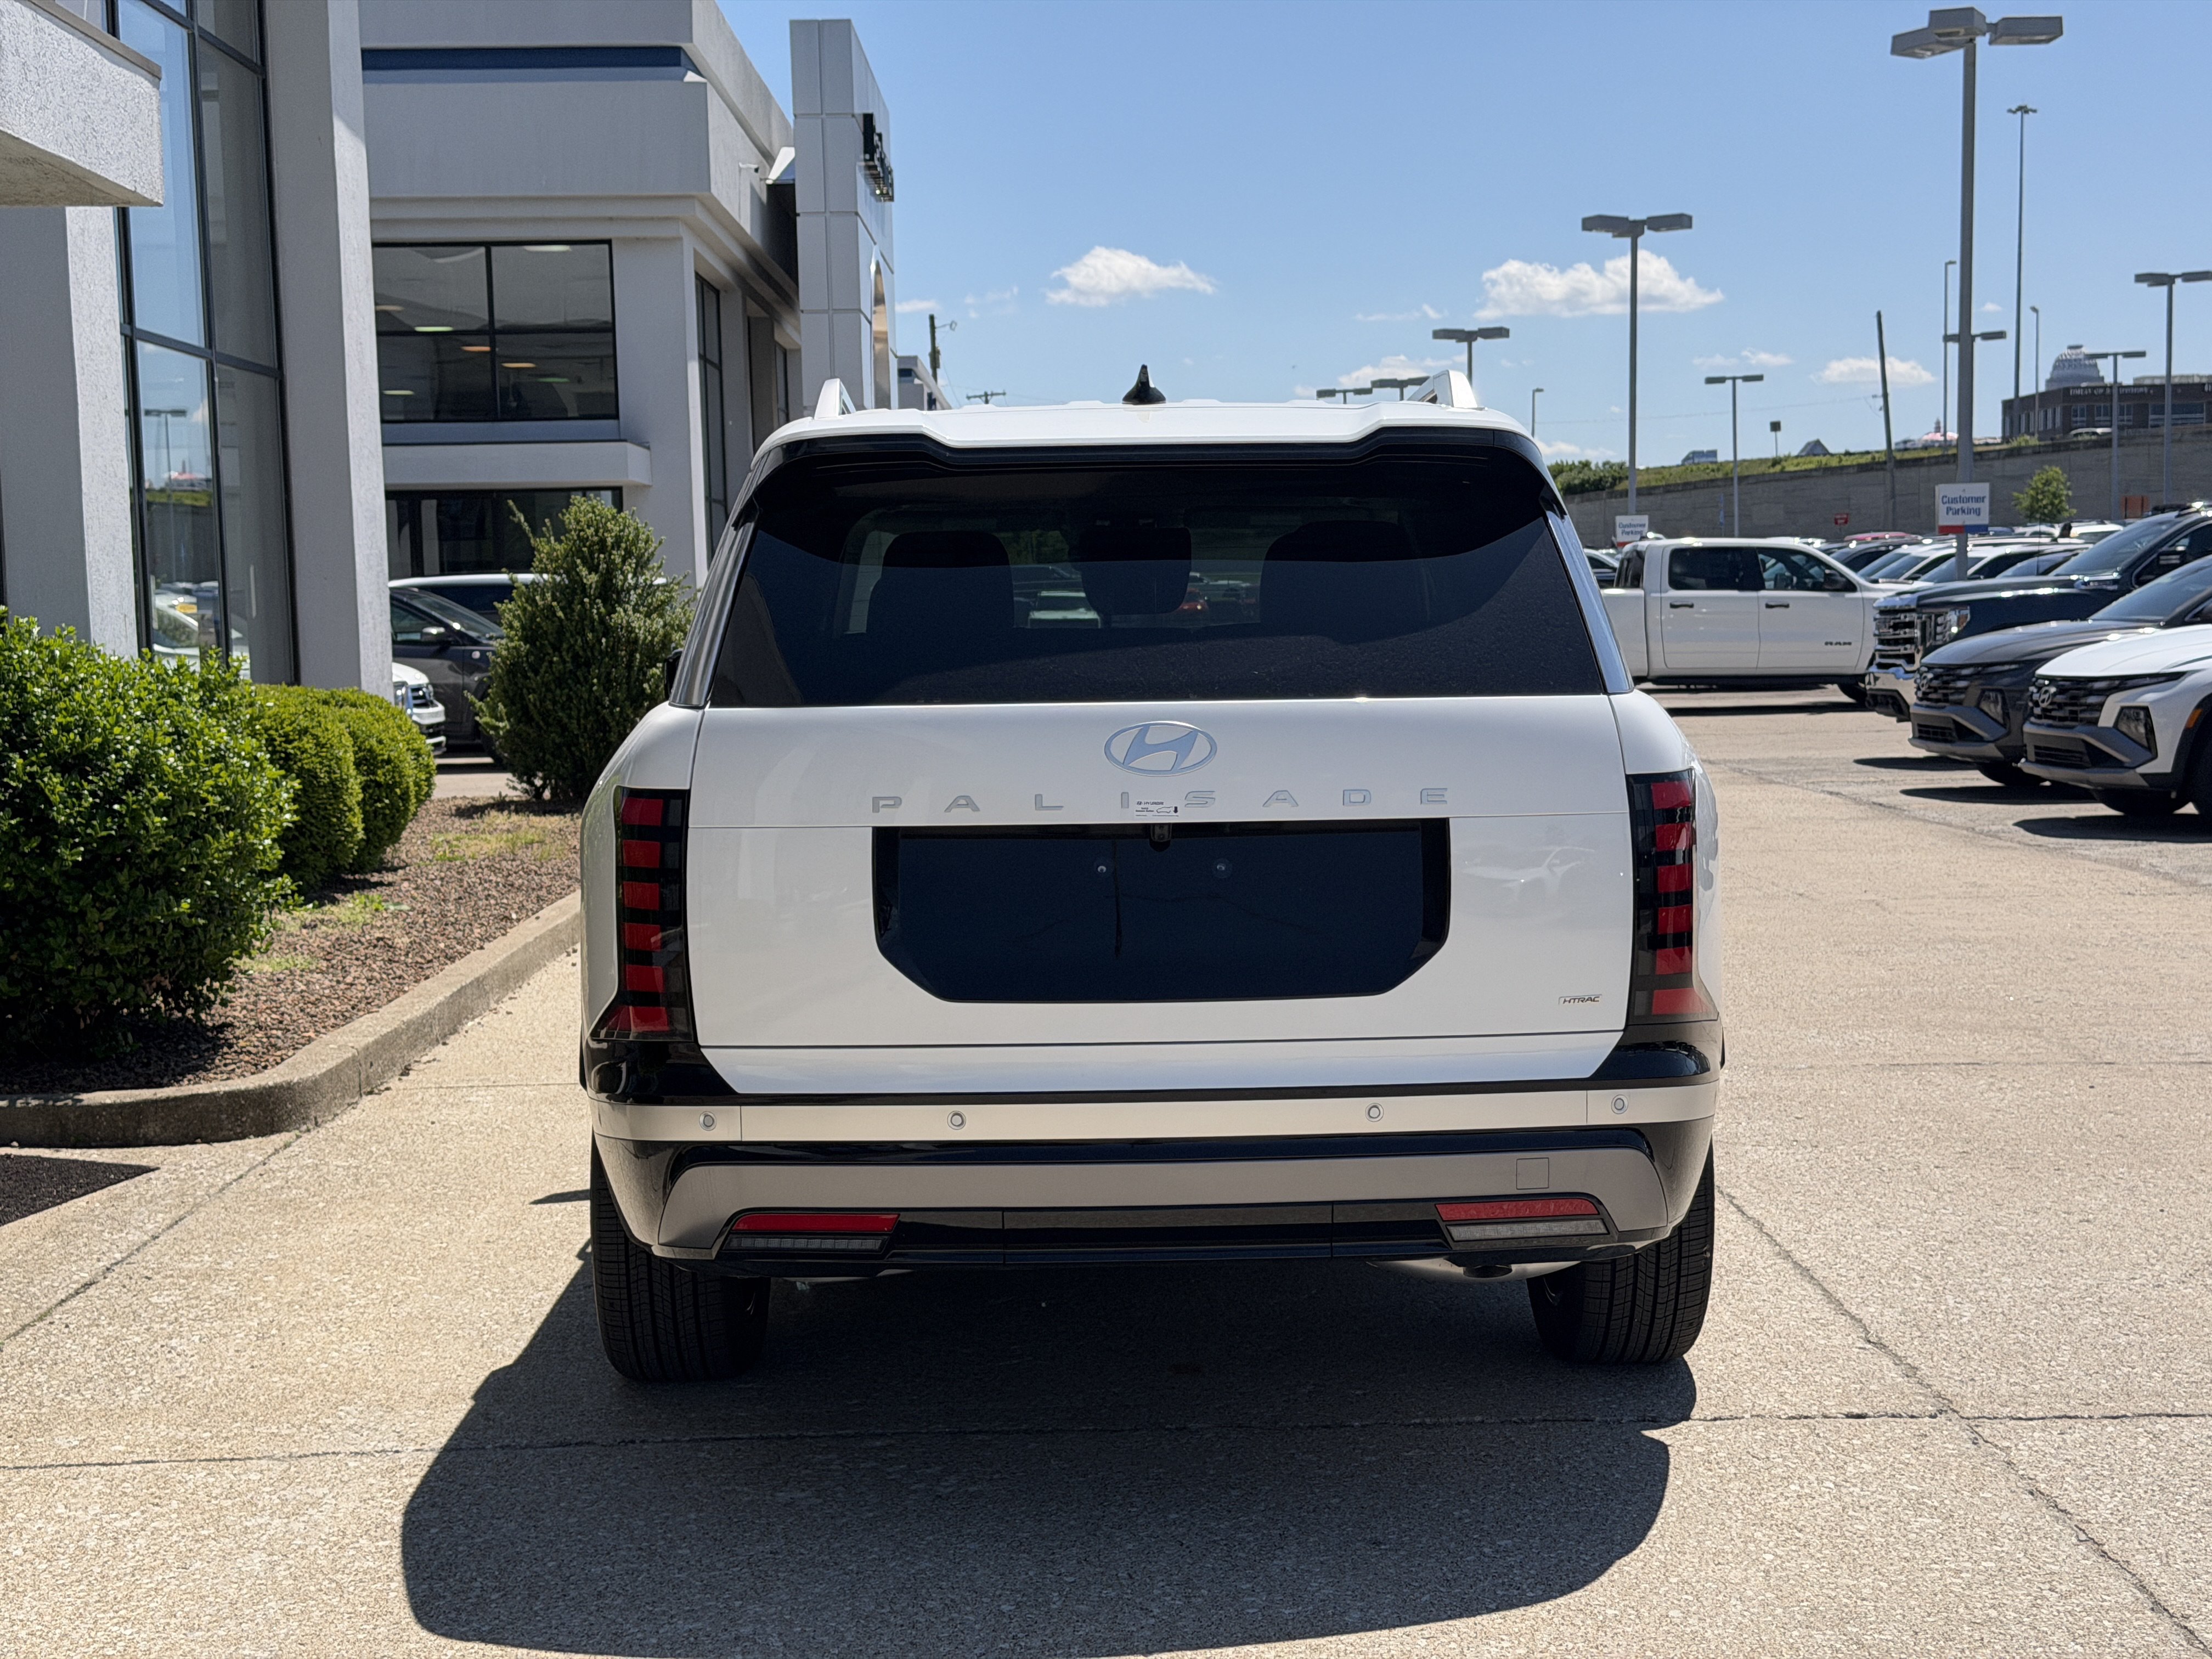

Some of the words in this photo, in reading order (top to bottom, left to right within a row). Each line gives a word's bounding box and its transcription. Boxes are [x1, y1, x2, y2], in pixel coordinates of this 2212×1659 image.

[1942, 495, 1986, 505] Customer
[1946, 506, 1981, 516] Parking
[872, 788, 1448, 813] PALISADE
